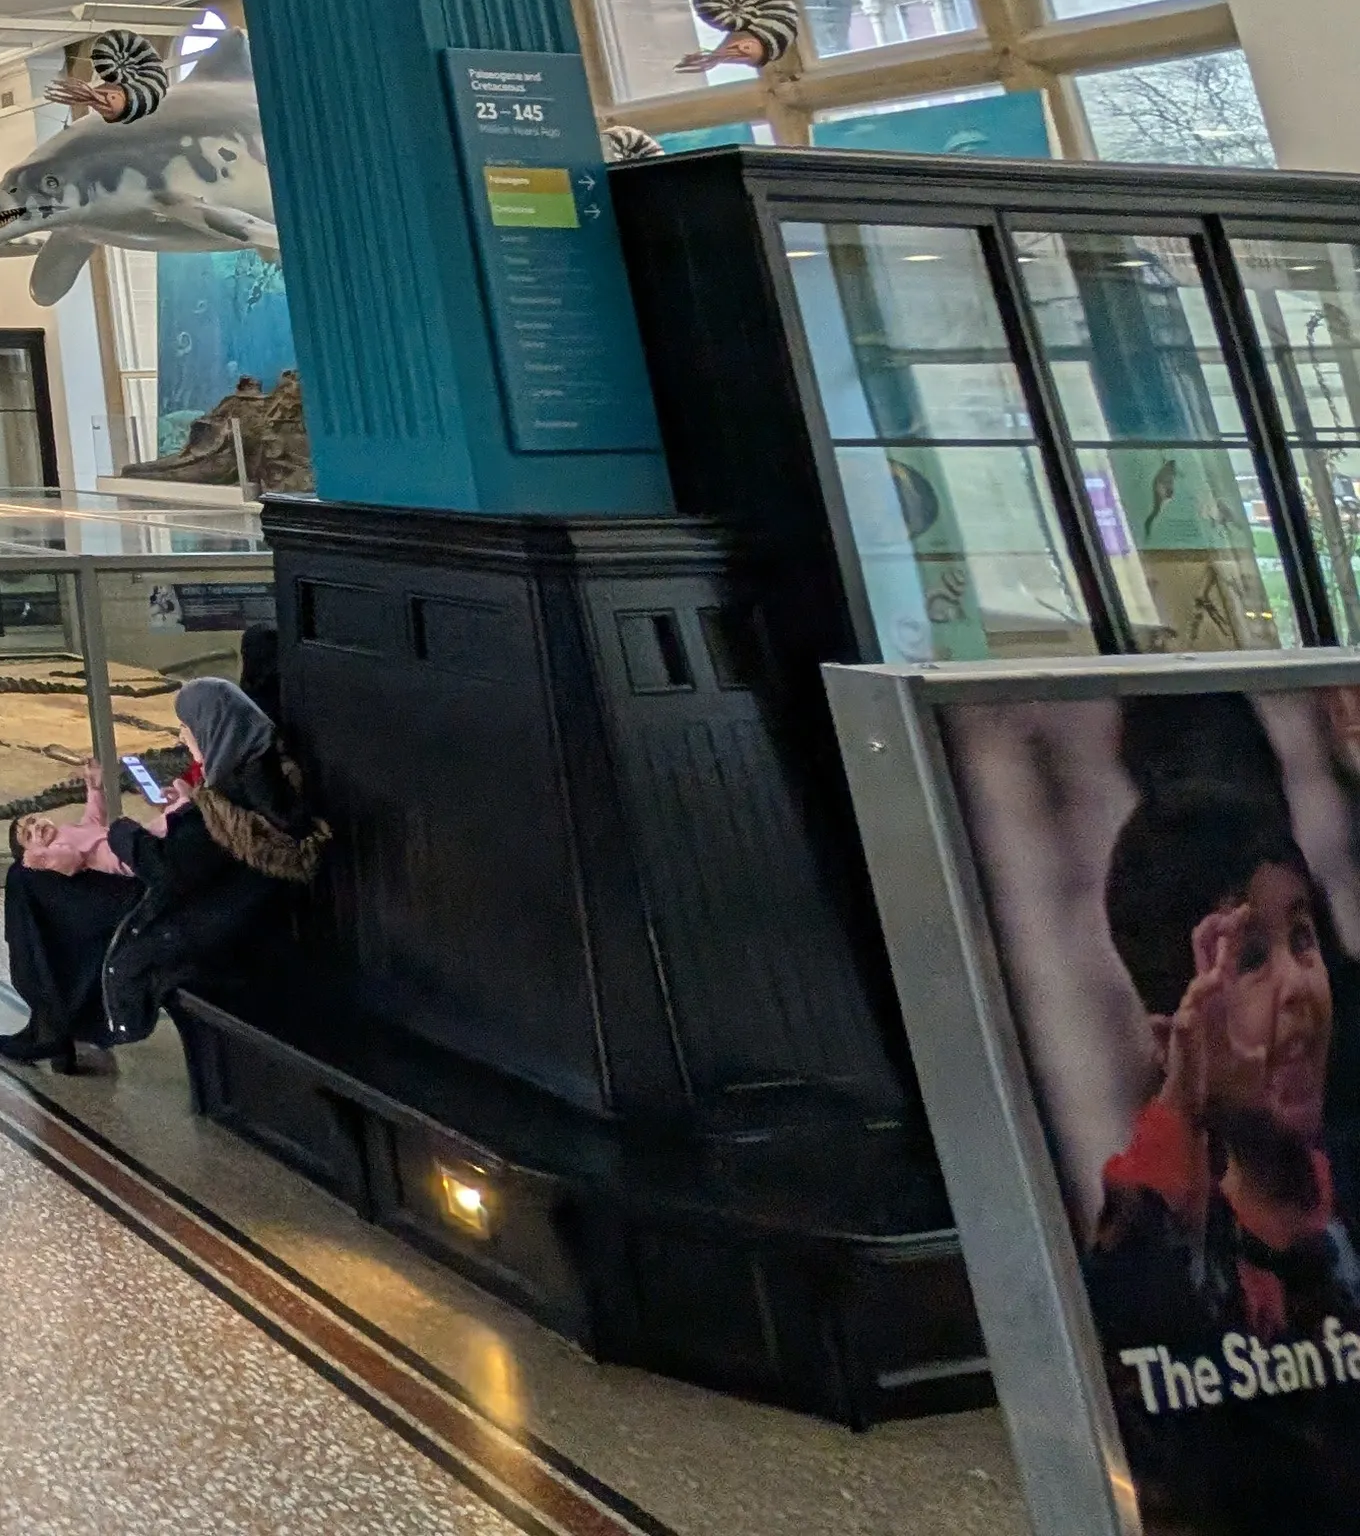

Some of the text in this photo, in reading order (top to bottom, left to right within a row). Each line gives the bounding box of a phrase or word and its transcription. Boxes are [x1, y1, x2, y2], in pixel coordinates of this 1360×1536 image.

[475, 101, 498, 120] 23
[512, 103, 544, 121] 145
[1119, 1345, 1223, 1414] The
[1222, 1332, 1327, 1400] Stan
